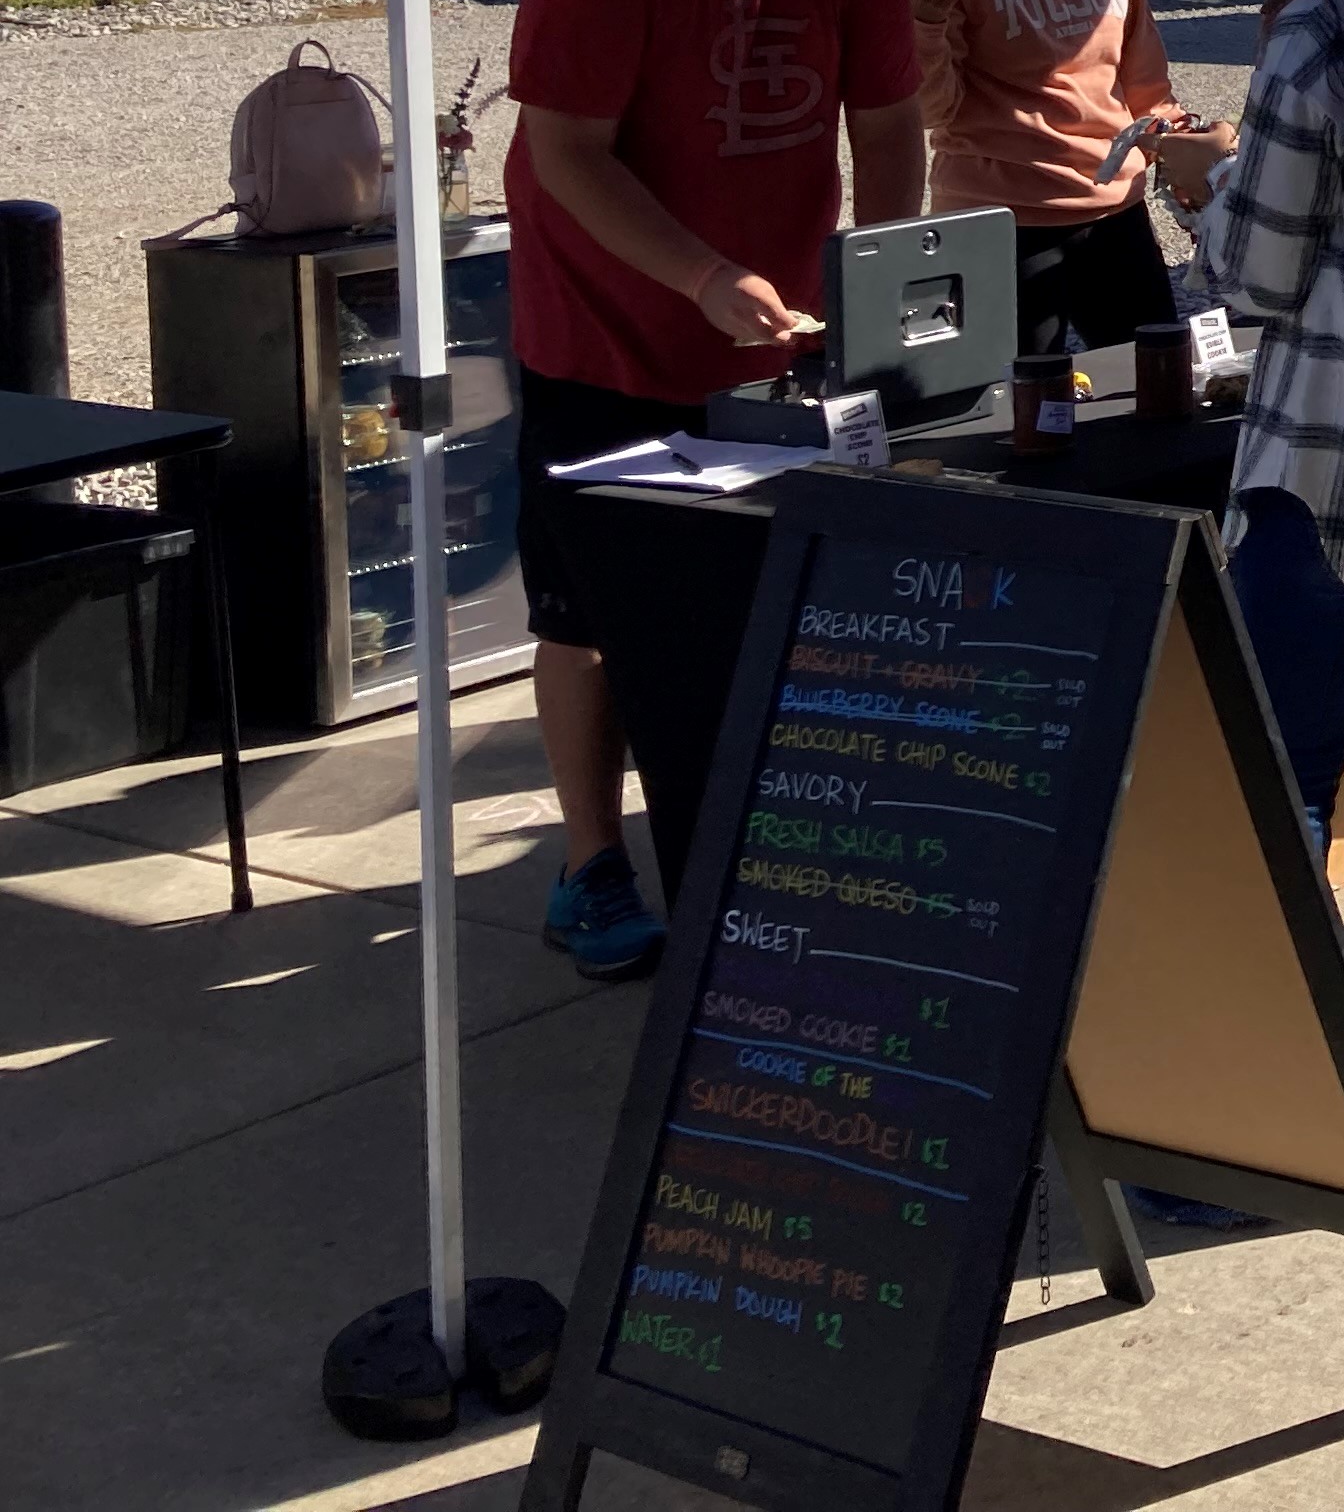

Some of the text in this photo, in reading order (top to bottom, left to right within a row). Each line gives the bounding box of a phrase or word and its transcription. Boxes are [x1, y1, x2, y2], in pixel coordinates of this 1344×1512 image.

[799, 605, 955, 650] BREAKFAST
[786, 644, 880, 679] BISCUIT
[900, 660, 983, 695] GRAVY
[780, 683, 905, 719] BLUEBERRY
[915, 701, 982, 734] SCONE
[769, 723, 1051, 798] CHOCOLATE CHIP SCONE $2
[759, 768, 868, 814] SAVORY
[744, 810, 948, 867] FRESH SALSA $5
[737, 857, 957, 920] SMOKED QUESO $5
[721, 910, 811, 964] SWEET
[703, 989, 792, 1033] SMOKED
[799, 1013, 879, 1054] COOKIE
[918, 995, 951, 1031] $1
[737, 1047, 809, 1086] COOKIE
[811, 1064, 838, 1088] OF
[839, 1072, 874, 1099] THE
[688, 1078, 915, 1162] SNICKERDOODLE!
[656, 1174, 721, 1221] PEACH
[724, 1200, 775, 1241] JAM
[782, 1214, 814, 1241] $5
[899, 1199, 929, 1229] $2
[643, 1222, 905, 1311] PUMPKIN WHOOPIE PIE $2
[629, 1263, 724, 1304] PUMPKIN
[734, 1284, 805, 1335] DOUGH
[620, 1310, 697, 1359] WATER
